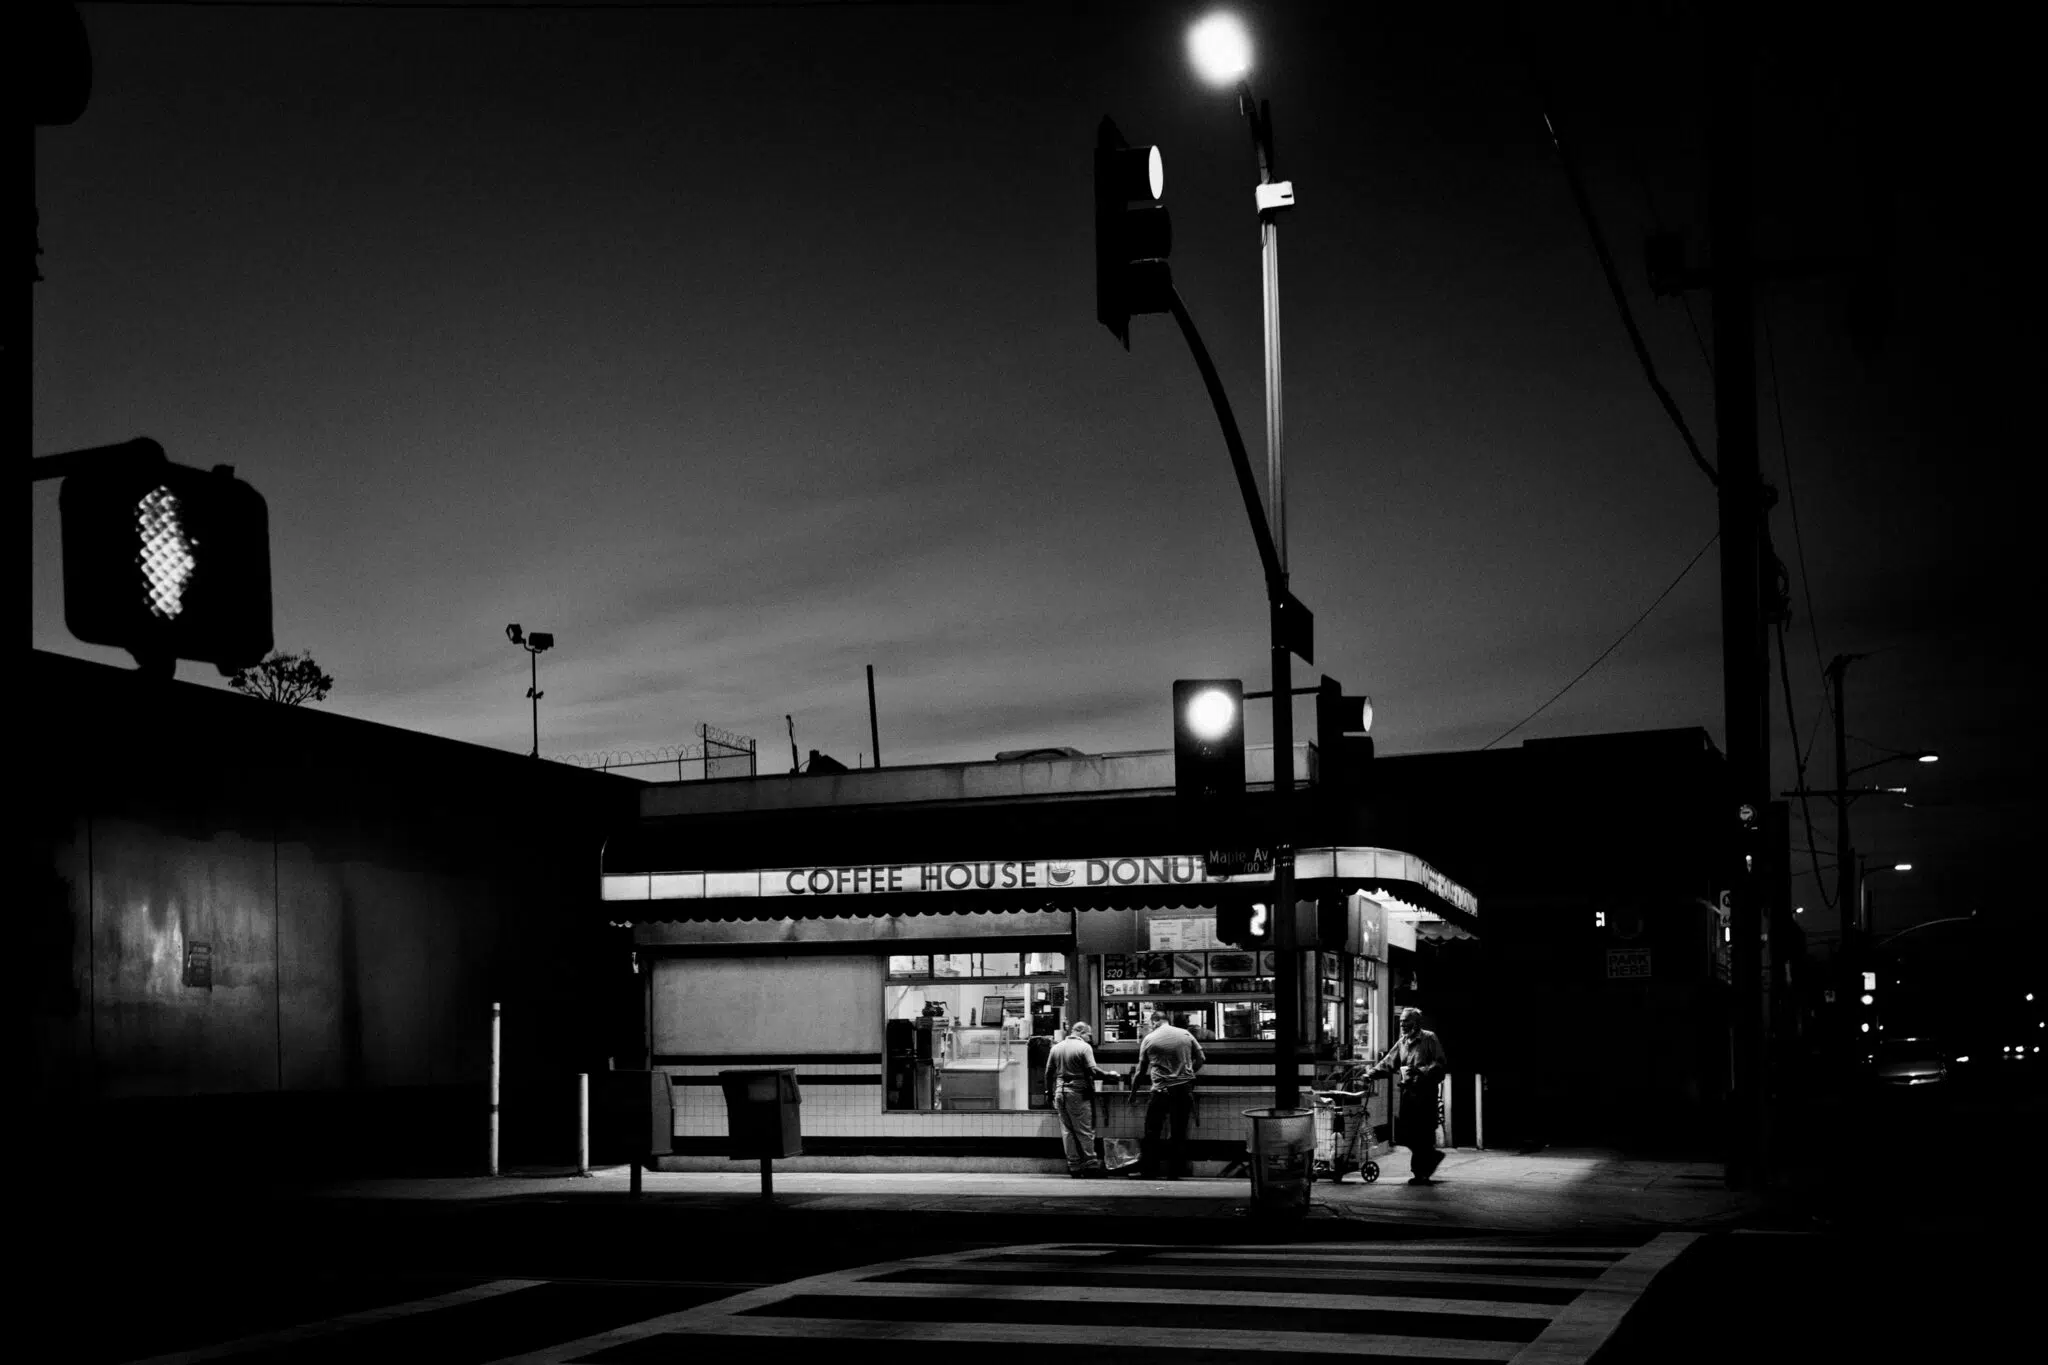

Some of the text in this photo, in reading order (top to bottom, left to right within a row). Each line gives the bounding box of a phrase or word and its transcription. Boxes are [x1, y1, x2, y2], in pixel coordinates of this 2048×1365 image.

[1209, 848, 1247, 866] Maple
[786, 857, 1230, 895] COFFEE HOUSE DONUT
[1609, 966, 1649, 976] HERE
